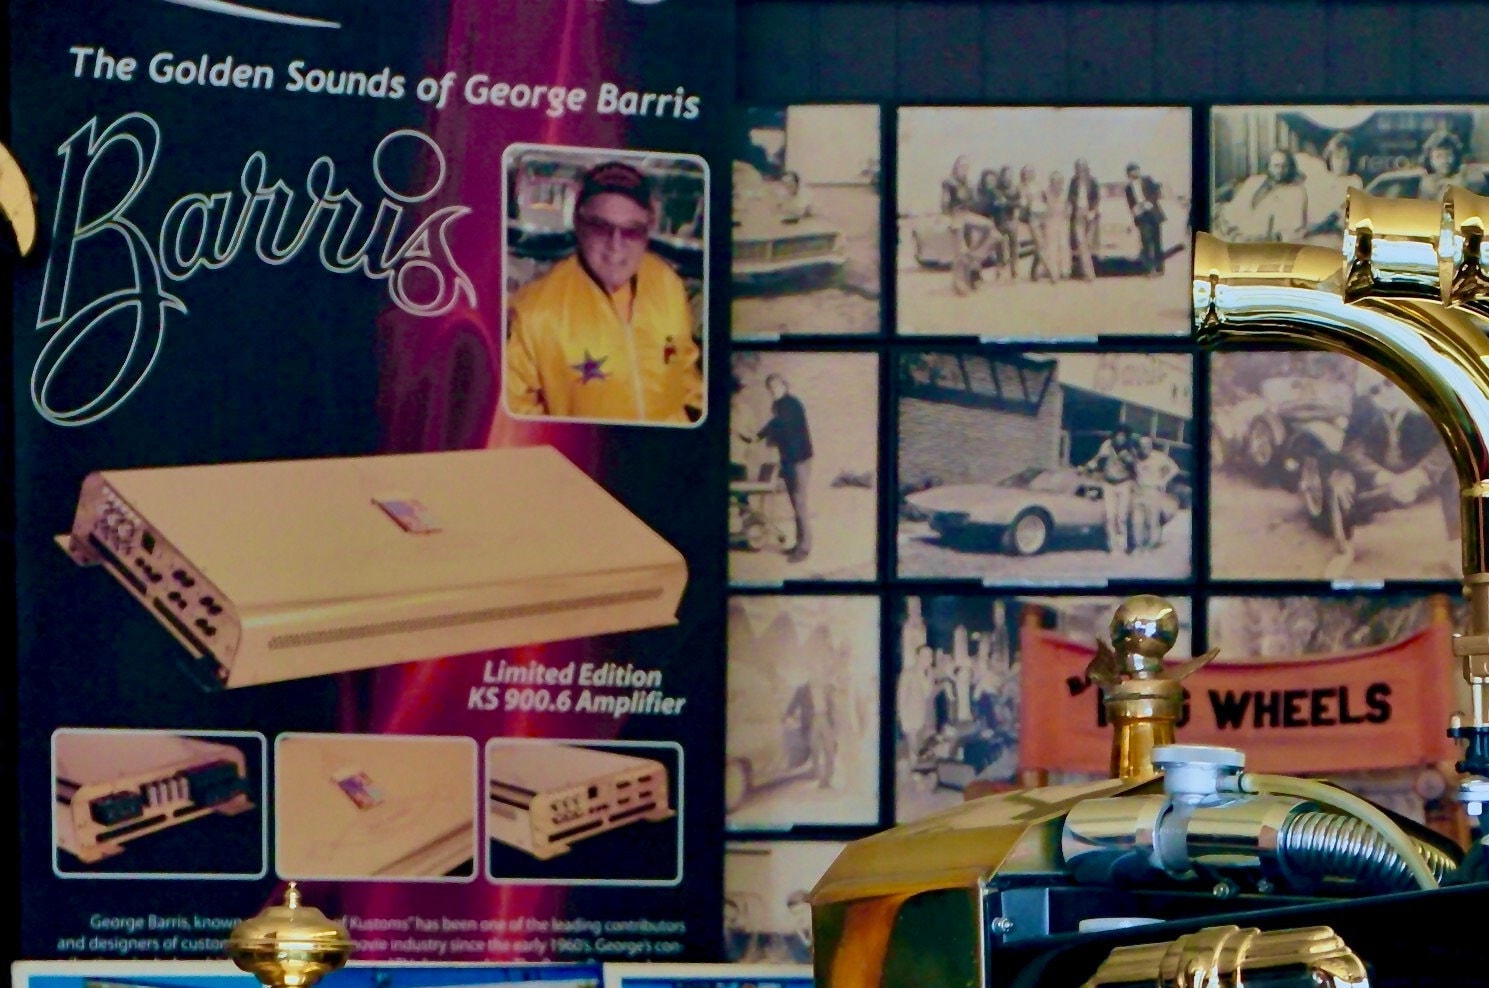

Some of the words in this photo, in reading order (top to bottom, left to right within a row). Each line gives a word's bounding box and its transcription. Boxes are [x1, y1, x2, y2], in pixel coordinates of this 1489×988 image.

[70, 46, 137, 82] The
[148, 52, 274, 90] Golden
[285, 60, 406, 100] Sounds
[416, 71, 457, 111] of
[464, 74, 587, 119] George
[596, 81, 701, 121] Barris
[30, 111, 477, 427] Barris
[483, 660, 576, 687] Limited
[578, 662, 663, 688] Edition
[467, 686, 499, 711] KS
[503, 688, 571, 712] 900.6
[575, 689, 687, 719] Amplifier
[1208, 682, 1393, 730] WHEELS
[90, 913, 145, 933] George
[148, 914, 191, 931] Barris,
[193, 914, 242, 930] known
[415, 914, 440, 932] has
[441, 915, 478, 932] been
[480, 919, 506, 932] one
[508, 916, 525, 932] of
[525, 916, 549, 932] the
[551, 916, 601, 936] leading
[604, 918, 687, 933] contributors
[57, 934, 85, 950] and
[88, 934, 160, 954] designers
[162, 934, 180, 950] of
[390, 936, 448, 956] industry
[450, 937, 485, 953] since
[487, 937, 510, 953] the
[512, 937, 546, 956] early
